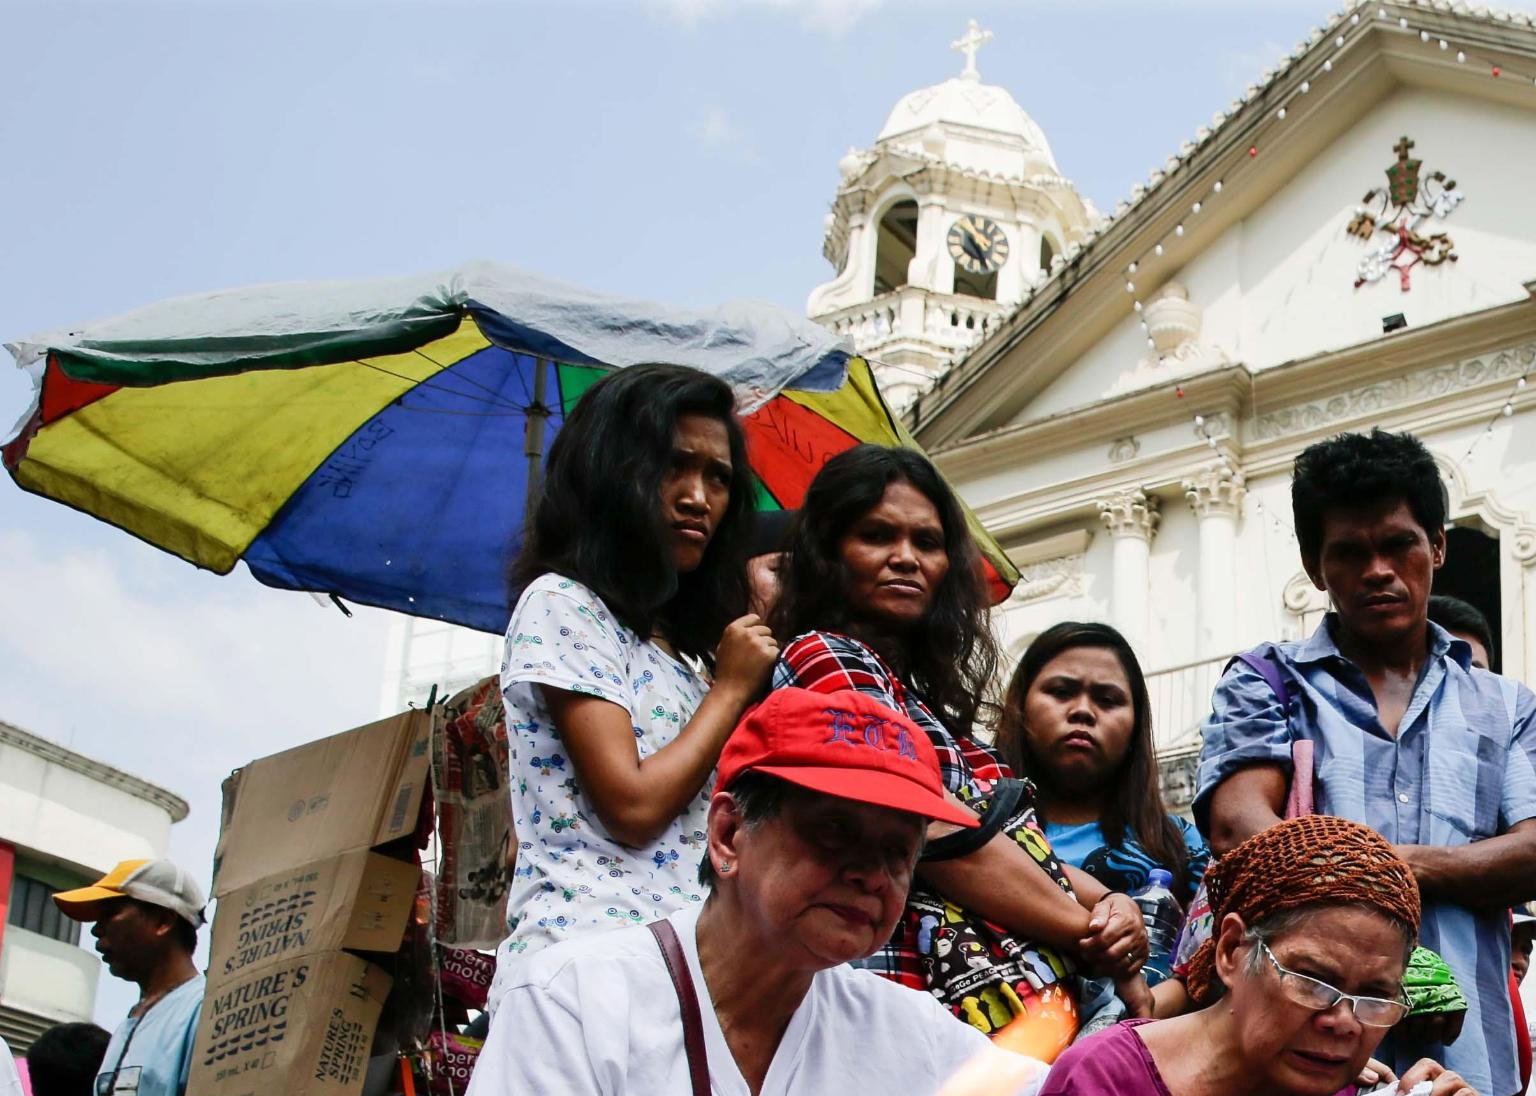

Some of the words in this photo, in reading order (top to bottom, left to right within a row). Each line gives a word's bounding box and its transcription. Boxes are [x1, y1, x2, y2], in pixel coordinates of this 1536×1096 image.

[223, 929, 311, 976] NATURE'S
[237, 912, 308, 950] SPRING
[210, 965, 310, 1020] NATURE'S
[211, 996, 291, 1040] SPRING
[315, 1007, 344, 1081] NATURE'S
[328, 1020, 352, 1079] SPRING
